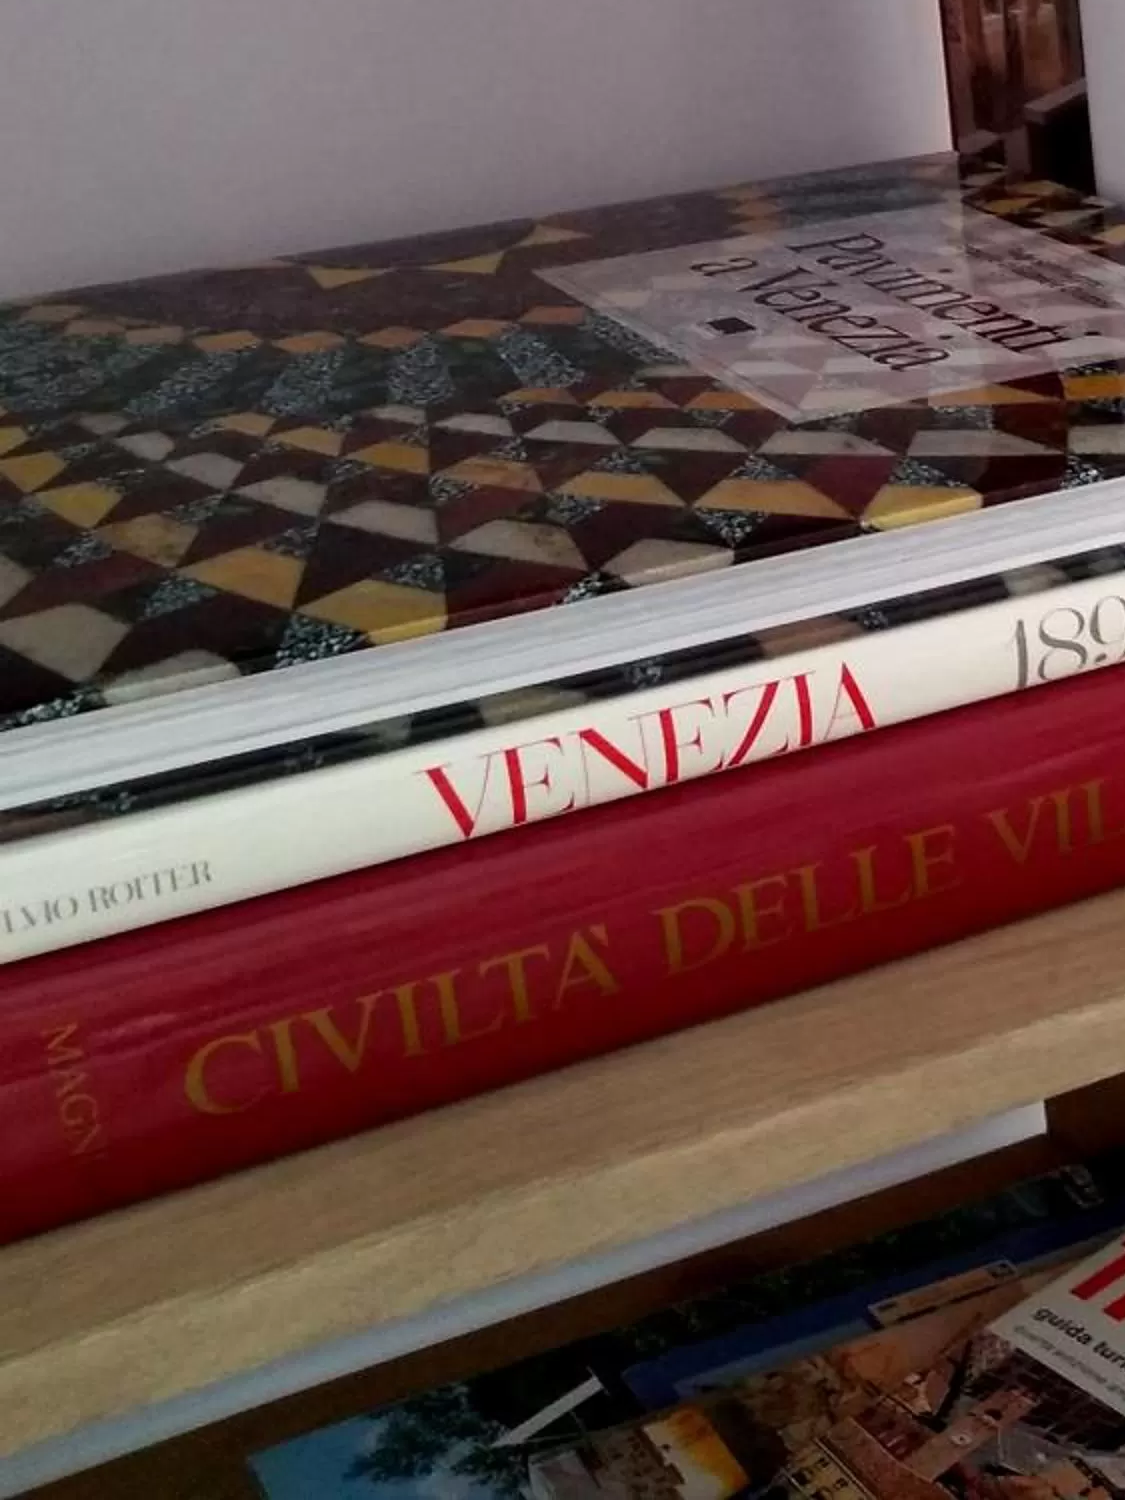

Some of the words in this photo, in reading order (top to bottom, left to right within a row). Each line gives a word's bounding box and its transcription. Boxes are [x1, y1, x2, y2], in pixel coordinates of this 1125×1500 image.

[690, 256, 758, 277] a
[740, 266, 950, 371] Venezia
[787, 231, 1101, 353] Pavimenti
[412, 661, 876, 839] VENEZIA
[651, 825, 962, 976] DELLE
[1032, 1306, 1093, 1346] guida
